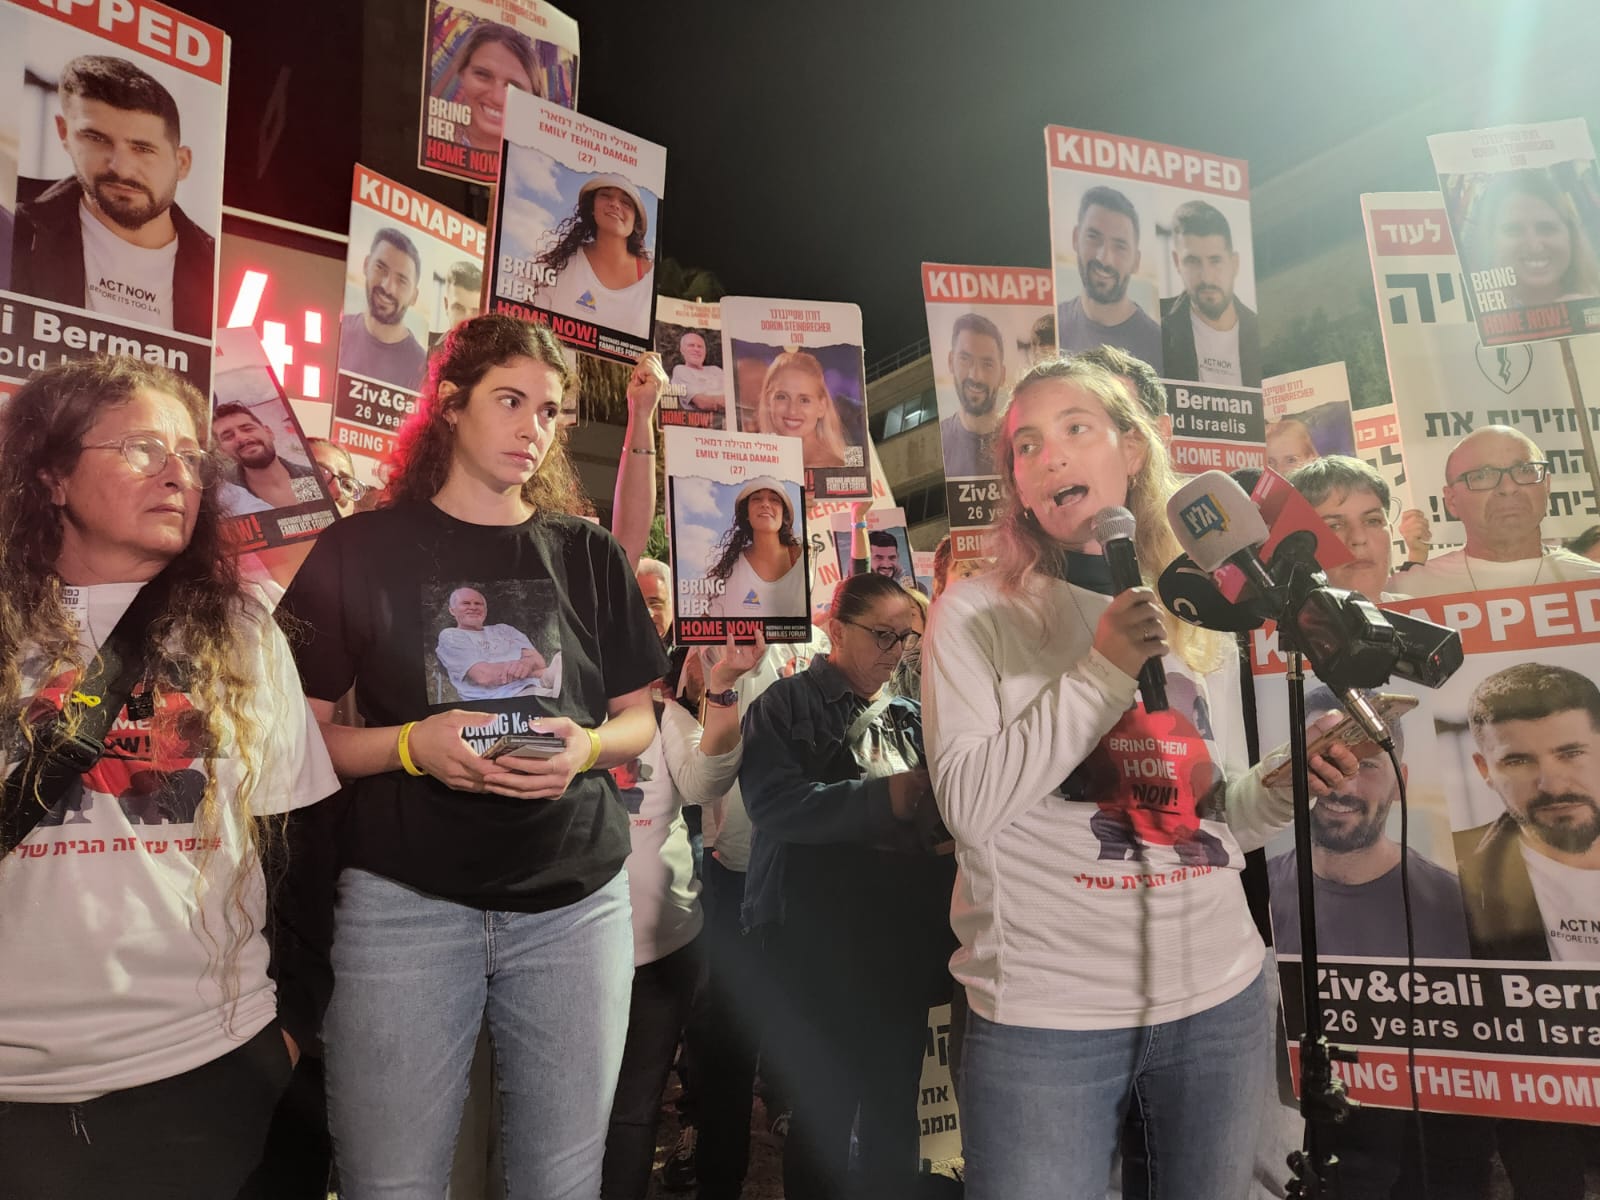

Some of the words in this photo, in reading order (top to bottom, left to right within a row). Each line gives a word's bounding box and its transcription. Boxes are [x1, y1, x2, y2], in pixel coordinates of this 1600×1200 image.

[429, 96, 472, 126] BRING
[427, 116, 455, 142] HER
[426, 138, 467, 168] HOME
[539, 121, 568, 140] EMILY
[570, 133, 601, 153] TEHILA
[602, 145, 638, 168] DAMARI
[577, 151, 597, 167] (27)
[1055, 132, 1242, 193] KIDNAPPED
[501, 255, 558, 288] BRING
[1470, 265, 1518, 292] BRING
[99, 277, 122, 293] ACT
[125, 286, 157, 303] NOW
[500, 277, 536, 304] HER
[1477, 289, 1508, 313] HER
[33, 310, 189, 373] Berman
[552, 316, 598, 343] NOW!
[355, 404, 371, 419] 26
[1175, 388, 1253, 415] Berman
[1190, 414, 1247, 434] Israelis
[1424, 411, 1475, 438] את
[339, 427, 383, 452] BRING
[695, 448, 720, 460] EMILY
[722, 451, 748, 462] TEHILA
[749, 453, 780, 465] DAMARI
[1175, 446, 1222, 467] HOME
[1224, 449, 1265, 471] NOW!
[730, 465, 746, 477] (27)
[967, 506, 984, 520] 26
[679, 579, 726, 596] BRING
[680, 599, 711, 616] HER
[681, 620, 723, 636] HOME
[1109, 738, 1156, 753] BRING
[1156, 739, 1188, 756] THEM
[1123, 757, 1178, 781] HOME
[1132, 783, 1179, 807] NOW!
[53, 838, 105, 856] הבית
[112, 836, 136, 851] זה
[1073, 872, 1115, 890] שלי
[1122, 871, 1166, 890] הבית
[1560, 918, 1588, 933] ACT
[1317, 968, 1484, 1007] Ziv&Gali
[1322, 1008, 1358, 1033] 26
[1370, 1017, 1459, 1041] years
[1472, 1017, 1525, 1043] old
[920, 1085, 949, 1106] את
[1406, 1065, 1501, 1102] THEM
